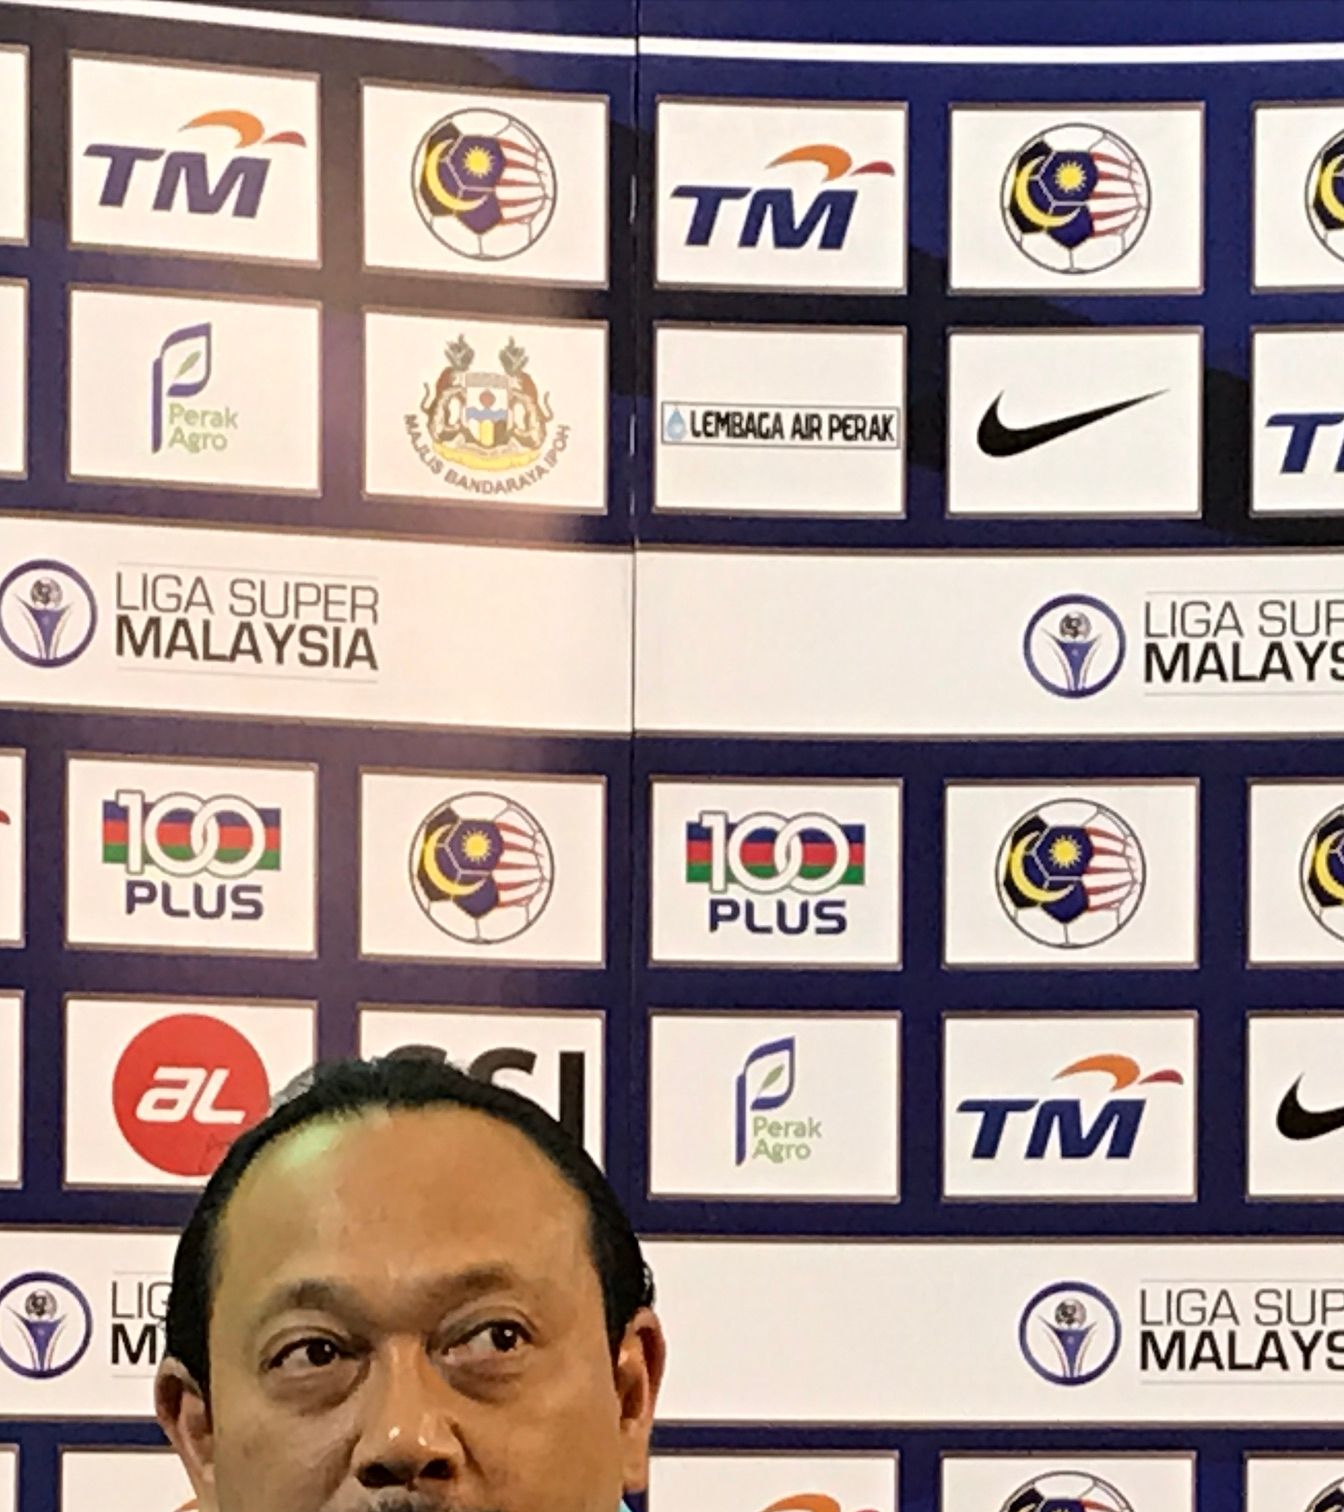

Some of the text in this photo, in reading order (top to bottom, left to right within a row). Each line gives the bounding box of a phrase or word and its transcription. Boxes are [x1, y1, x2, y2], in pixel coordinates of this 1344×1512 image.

[84, 143, 272, 219] TM
[670, 184, 860, 251] TM
[168, 402, 239, 430] Perak
[690, 410, 895, 442] LEMBAGA AIR PERAK
[168, 429, 228, 454] Agro
[115, 571, 380, 625] LIGA SUPER
[1144, 600, 1245, 639] LIGA
[115, 615, 380, 671] MALAYSIA
[115, 789, 269, 879] 100
[697, 810, 851, 894] 100
[125, 877, 264, 921] PLUS
[708, 898, 848, 936] PLUS
[752, 1114, 823, 1139] Perak
[955, 1098, 1148, 1161] TM
[752, 1139, 812, 1164] Agro
[111, 1280, 173, 1319] LIG
[1140, 1288, 1240, 1327] LIGA
